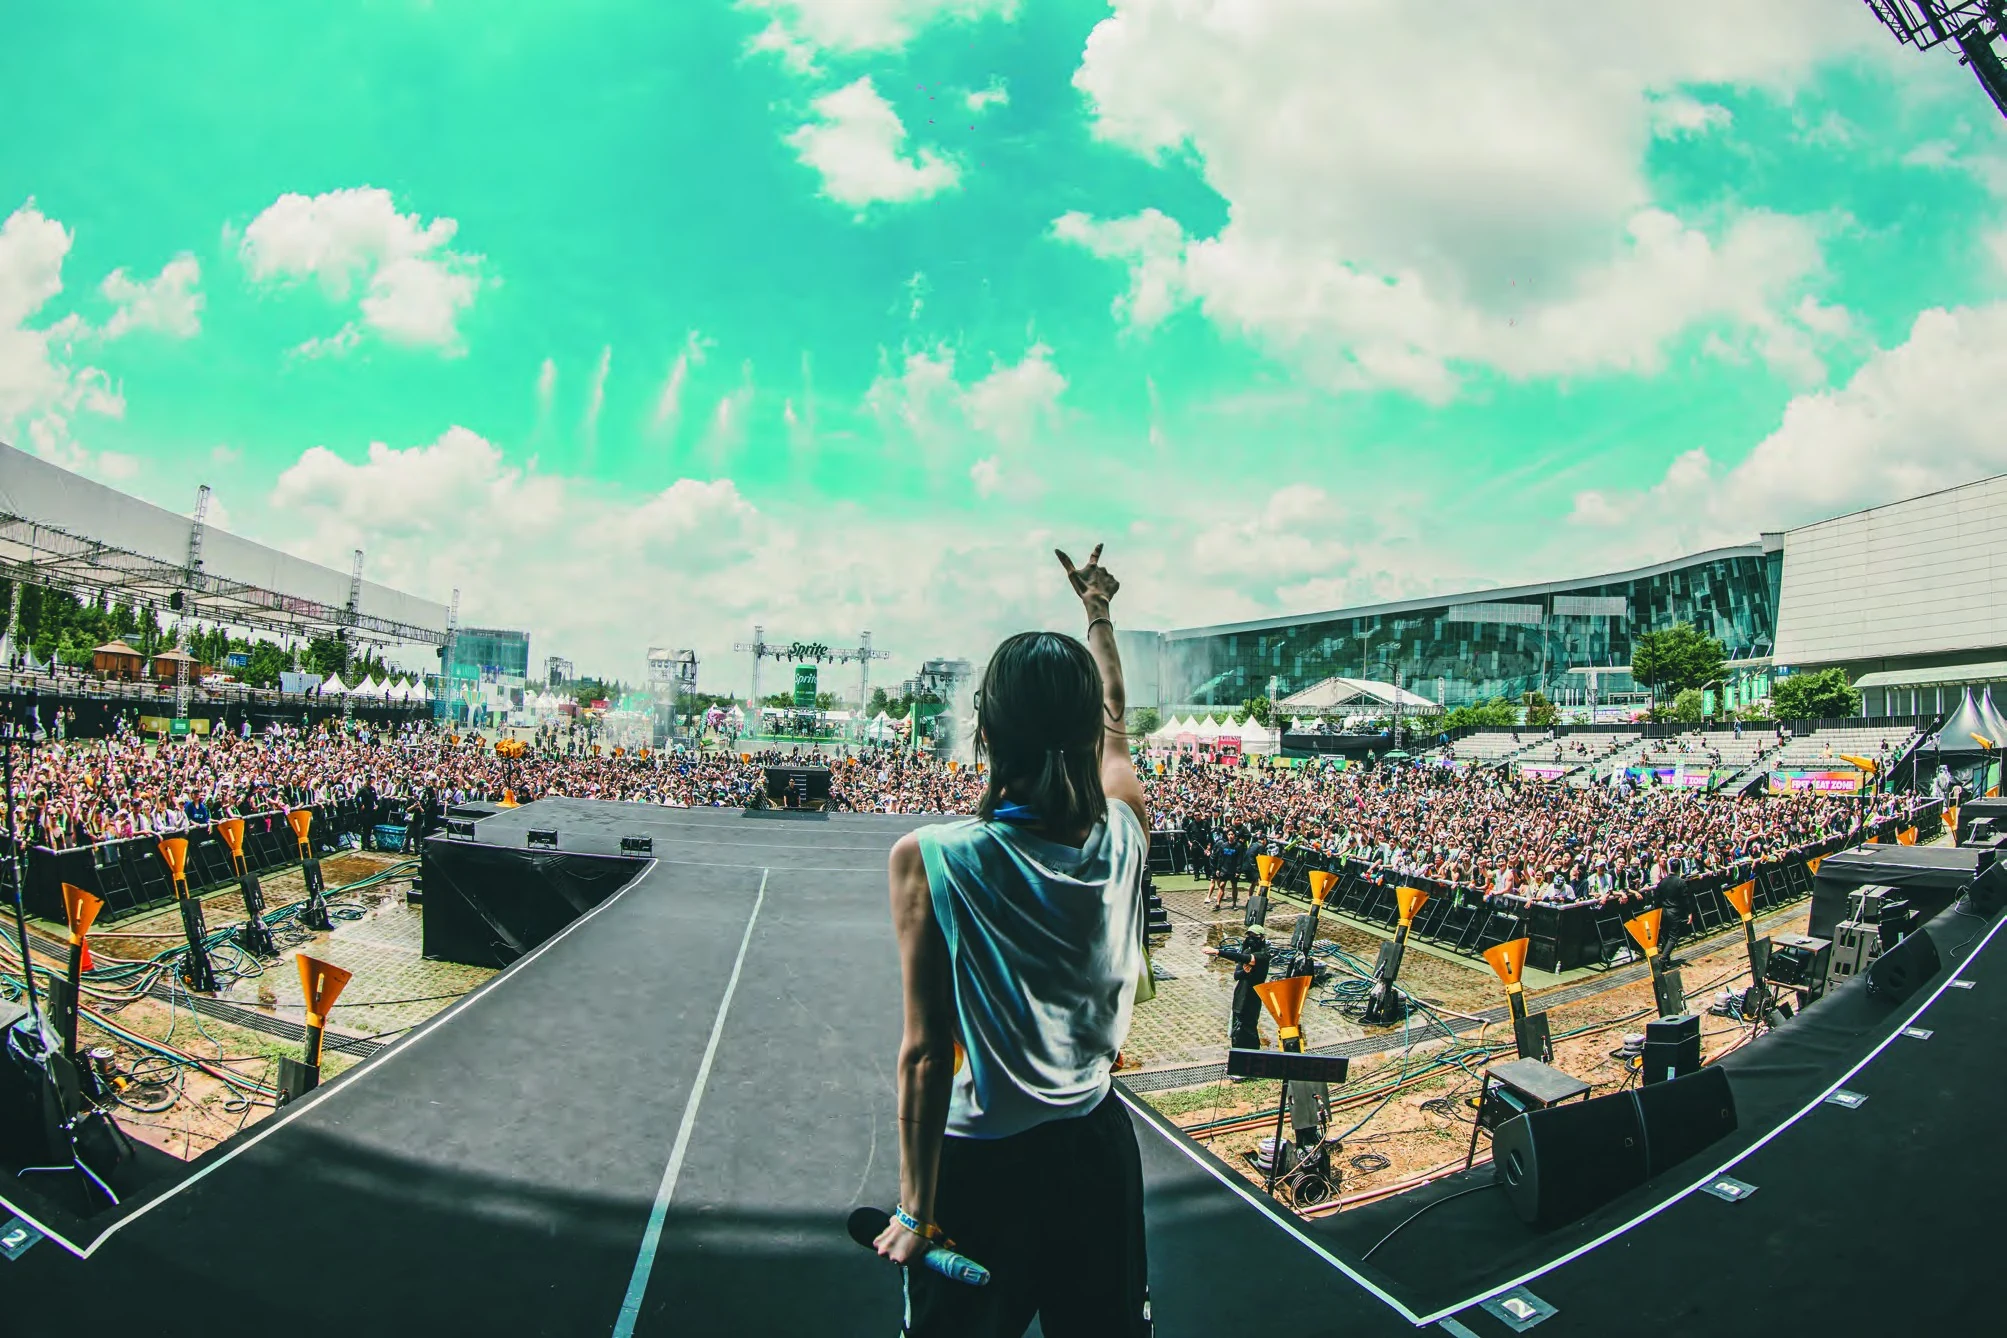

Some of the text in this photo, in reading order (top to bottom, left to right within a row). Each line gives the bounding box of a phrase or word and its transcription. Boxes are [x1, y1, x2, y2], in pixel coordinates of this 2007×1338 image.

[790, 642, 828, 657] Sprite
[1791, 780, 1810, 789] FREE
[1831, 780, 1854, 790] ZONE
[900, 1213, 920, 1230] SAT
[1, 1229, 27, 1248] 2
[1501, 1297, 1537, 1320] 2
